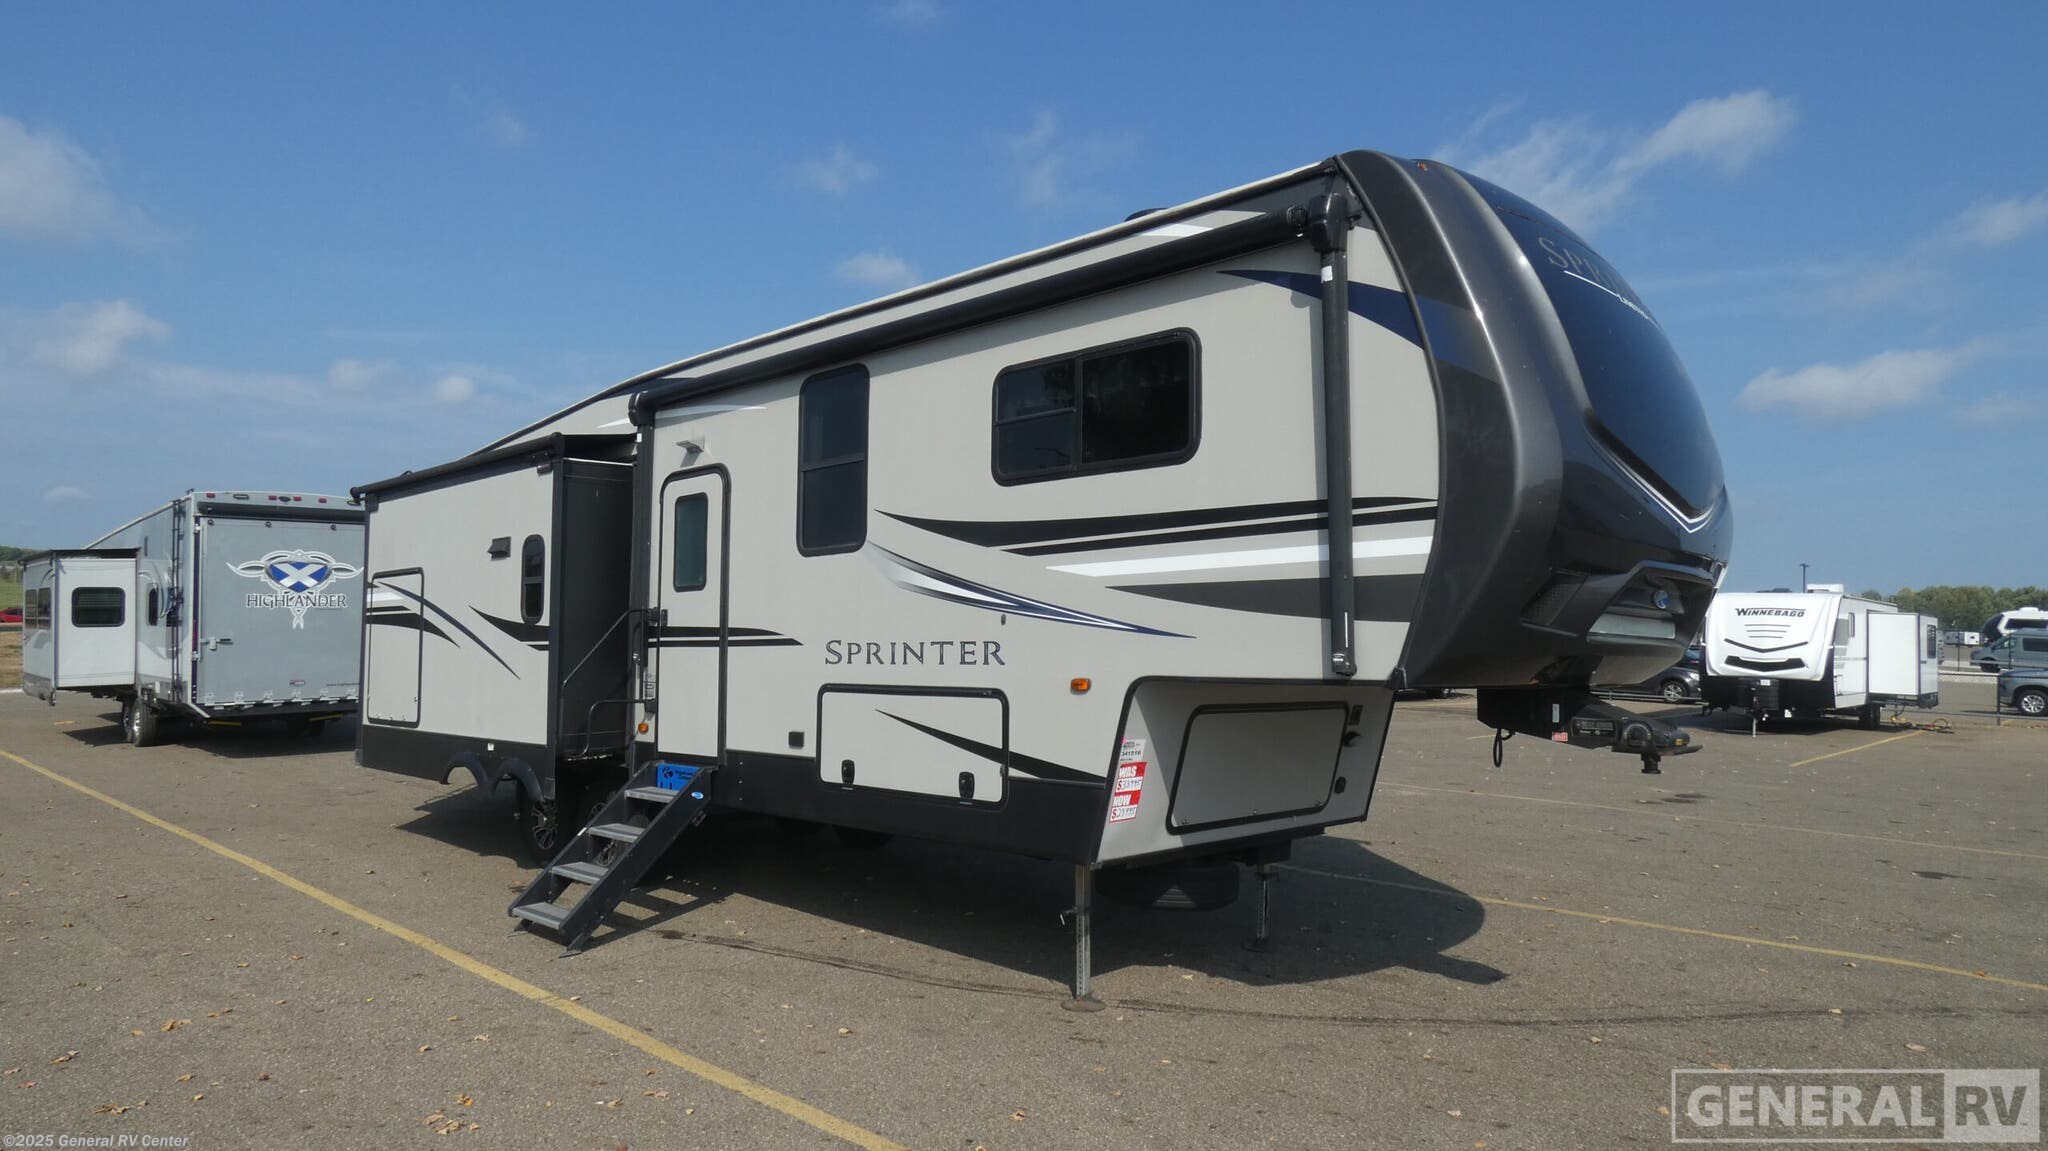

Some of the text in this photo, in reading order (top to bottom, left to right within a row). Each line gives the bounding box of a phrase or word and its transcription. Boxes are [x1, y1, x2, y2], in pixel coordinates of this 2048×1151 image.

[246, 593, 347, 608] HIGHLANDER
[1735, 608, 1806, 617] WINNEBAGO
[825, 640, 1005, 666] SPRINTER
[1119, 766, 1137, 778] WAS
[1113, 794, 1131, 806] NOW
